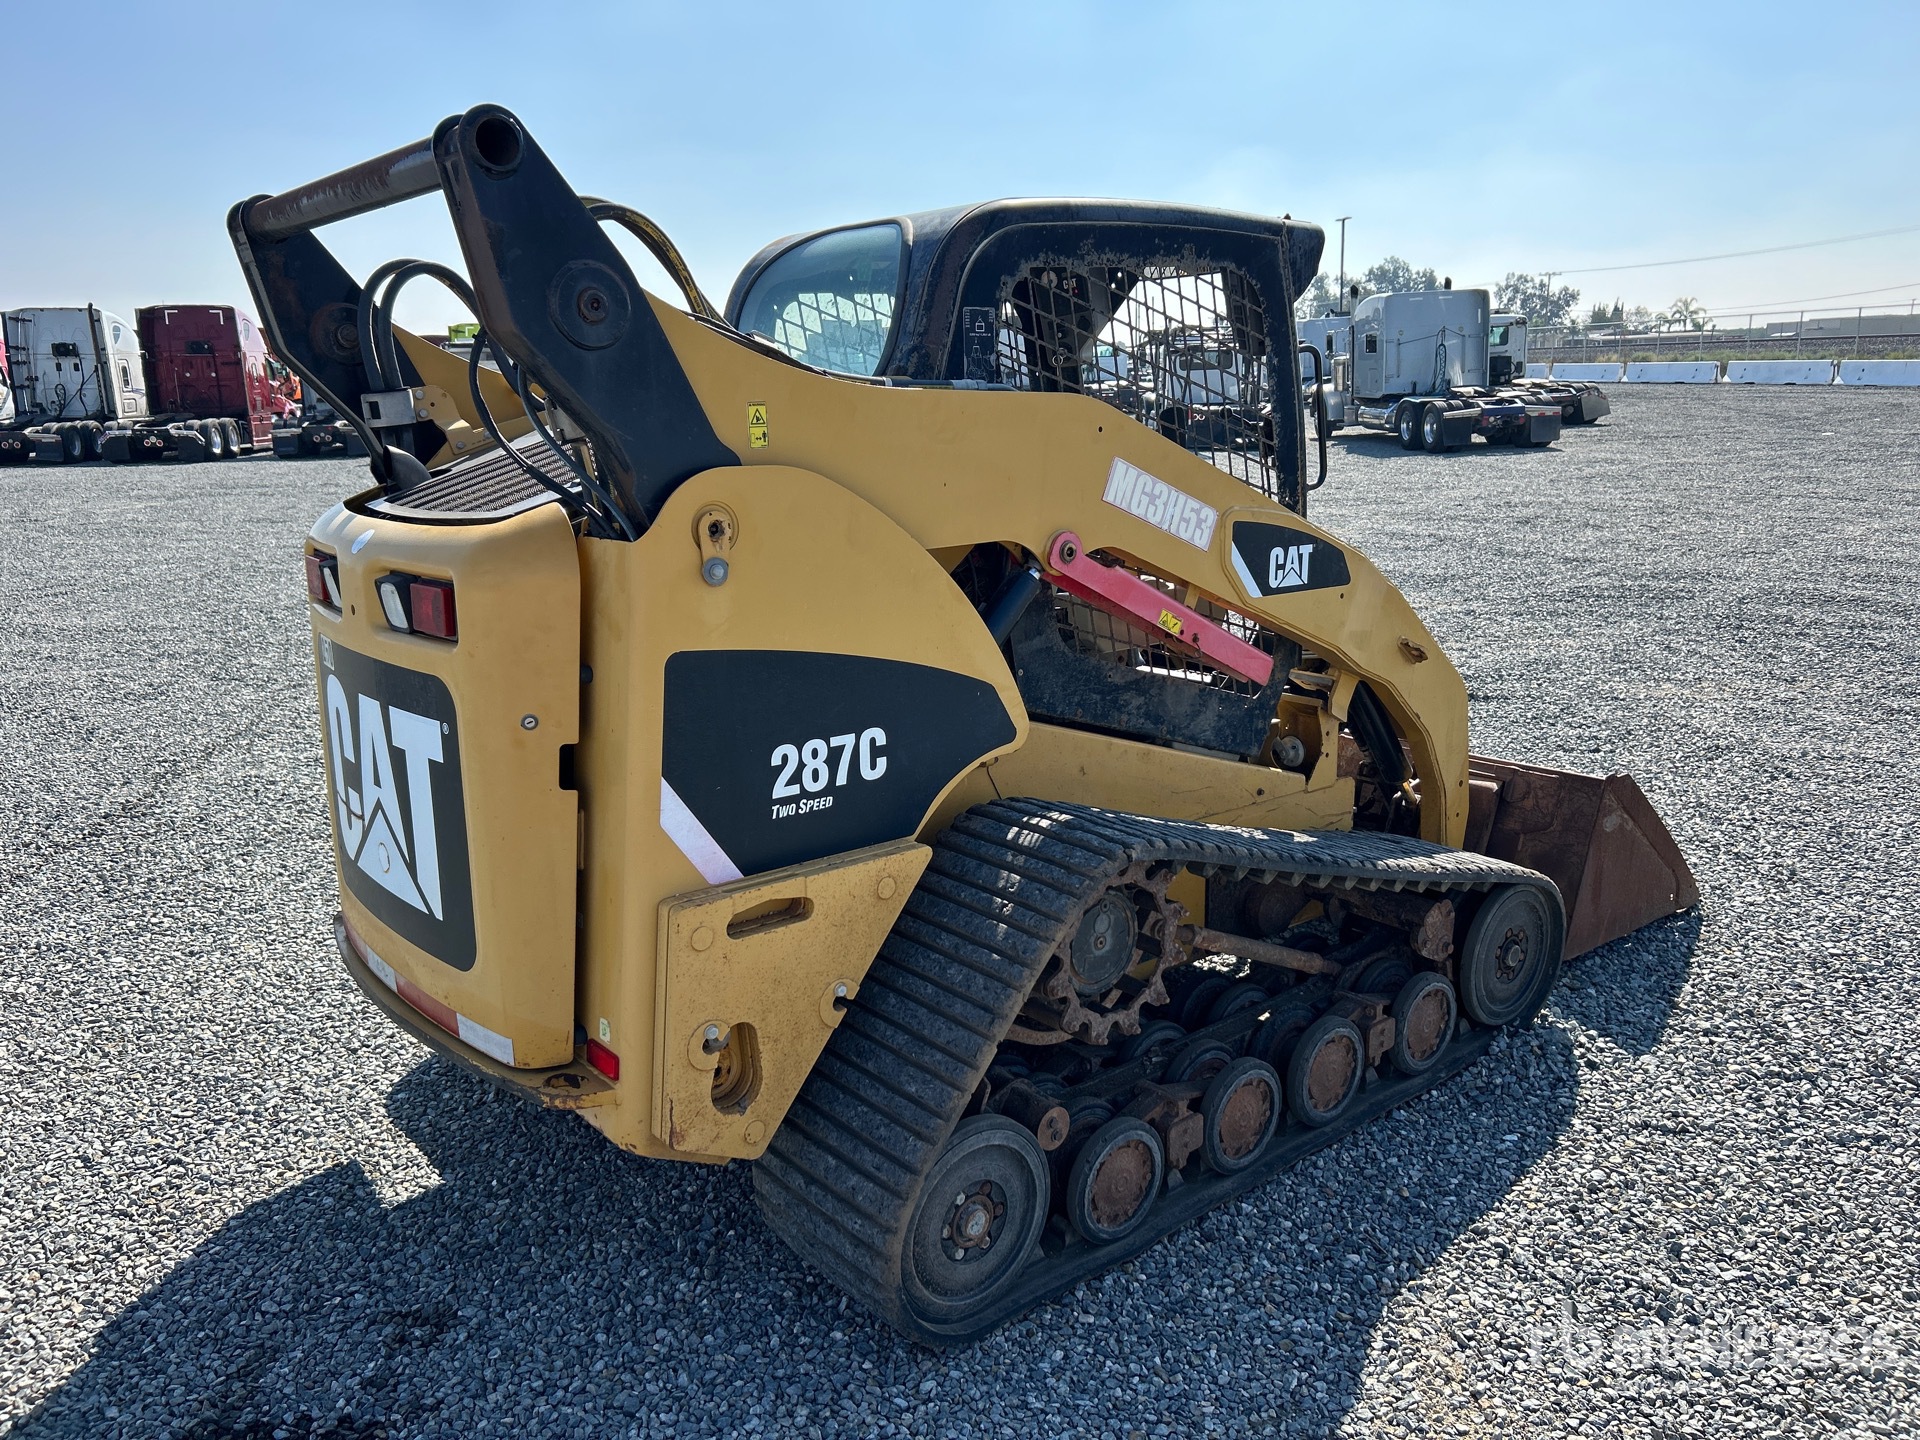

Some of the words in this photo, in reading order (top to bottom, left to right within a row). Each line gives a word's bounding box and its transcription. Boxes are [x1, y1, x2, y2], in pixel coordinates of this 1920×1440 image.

[1268, 543, 1314, 589] CAT
[327, 674, 444, 922] CAT
[770, 727, 888, 800] 287C
